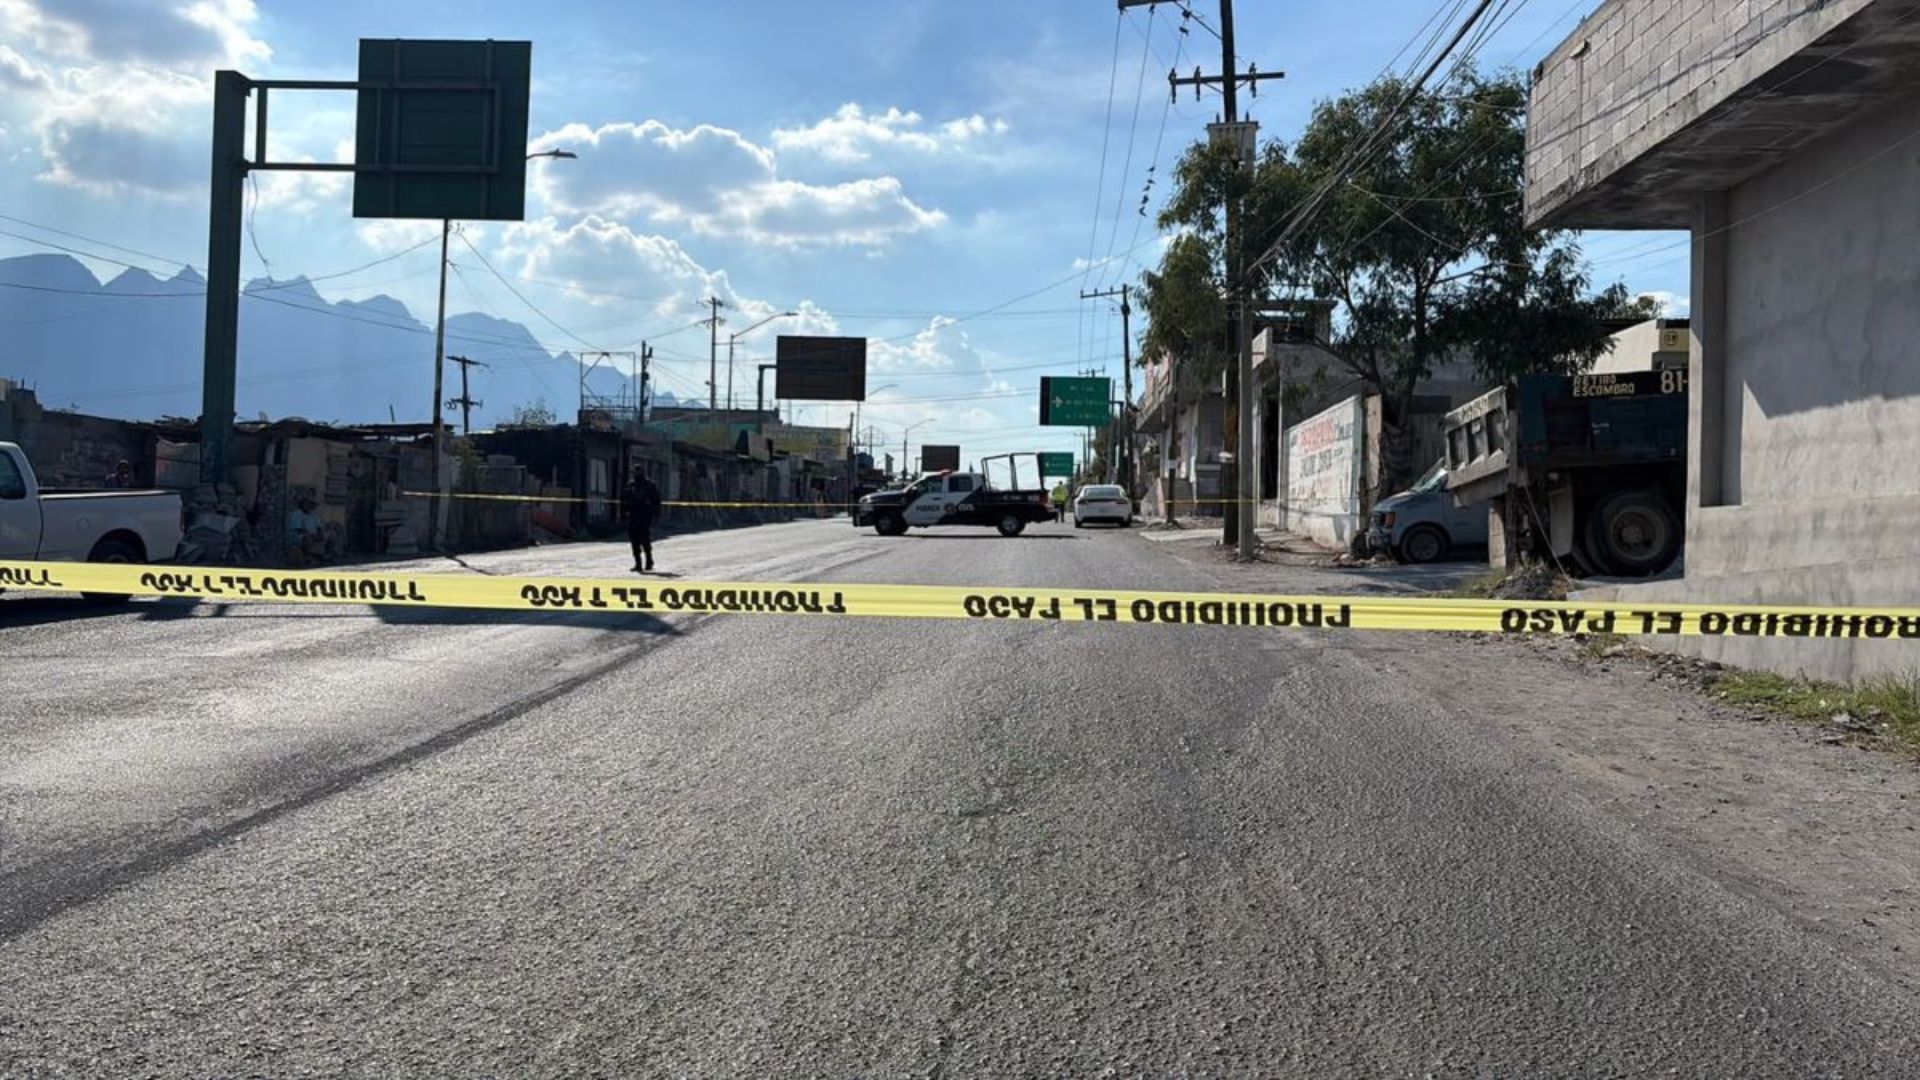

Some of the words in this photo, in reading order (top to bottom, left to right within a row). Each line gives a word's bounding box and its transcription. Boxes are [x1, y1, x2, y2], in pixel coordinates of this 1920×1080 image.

[1573, 374, 1617, 387] RETIRO
[1573, 383, 1635, 397] ESCOMBRO
[1500, 607, 1616, 634] PASO
[1632, 610, 1684, 634] EL
